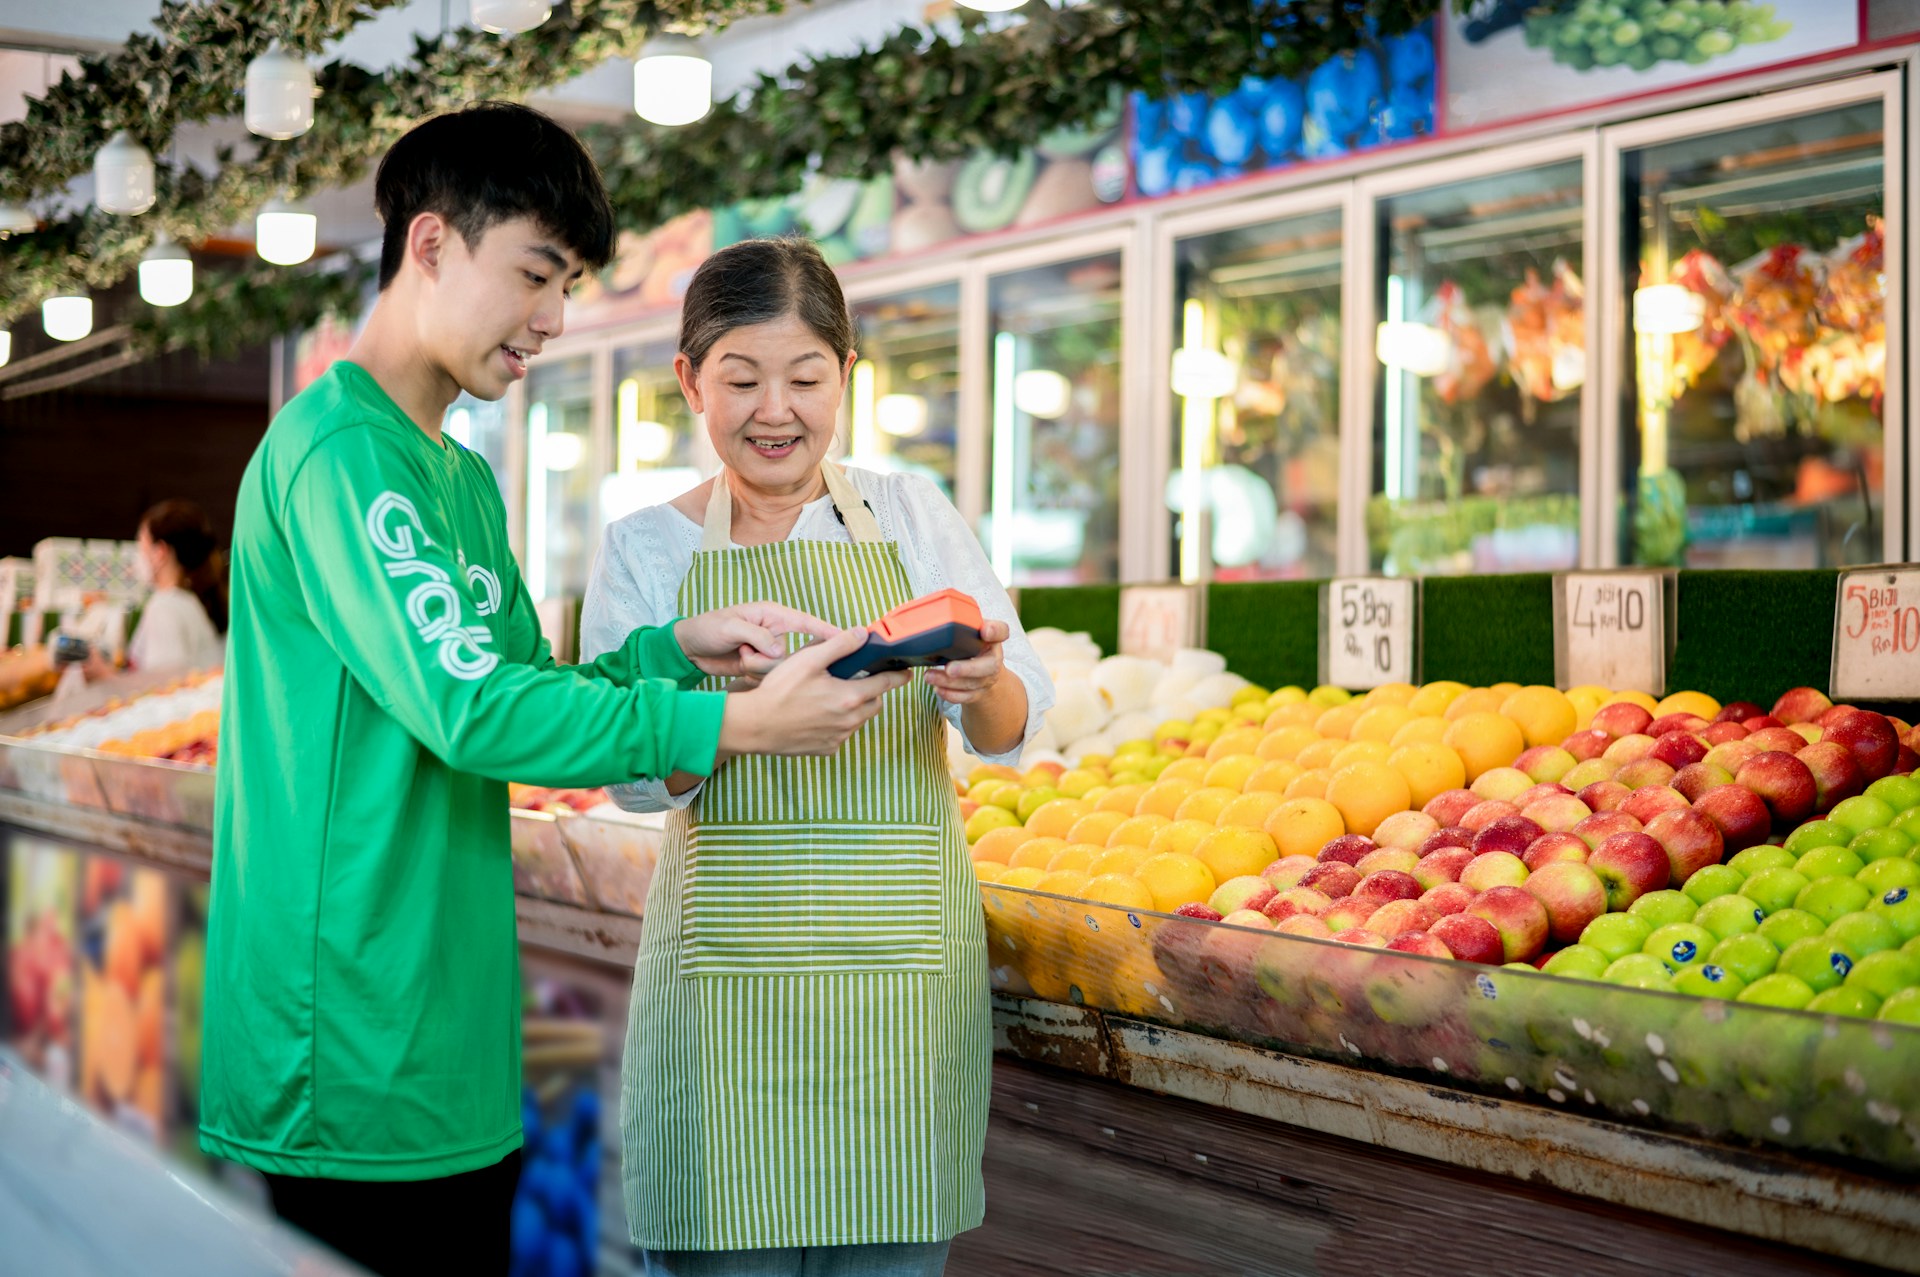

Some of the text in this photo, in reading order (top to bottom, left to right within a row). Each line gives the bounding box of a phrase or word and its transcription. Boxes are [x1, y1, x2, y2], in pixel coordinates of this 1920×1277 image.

[366, 490, 499, 681] Grab
[1341, 584, 1358, 628] 5
[1618, 587, 1643, 631] 10
[1573, 584, 1596, 638] 4
[1846, 585, 1898, 639] 5 BIJI
[1892, 606, 1920, 654] 10
[1374, 634, 1391, 673] 10
